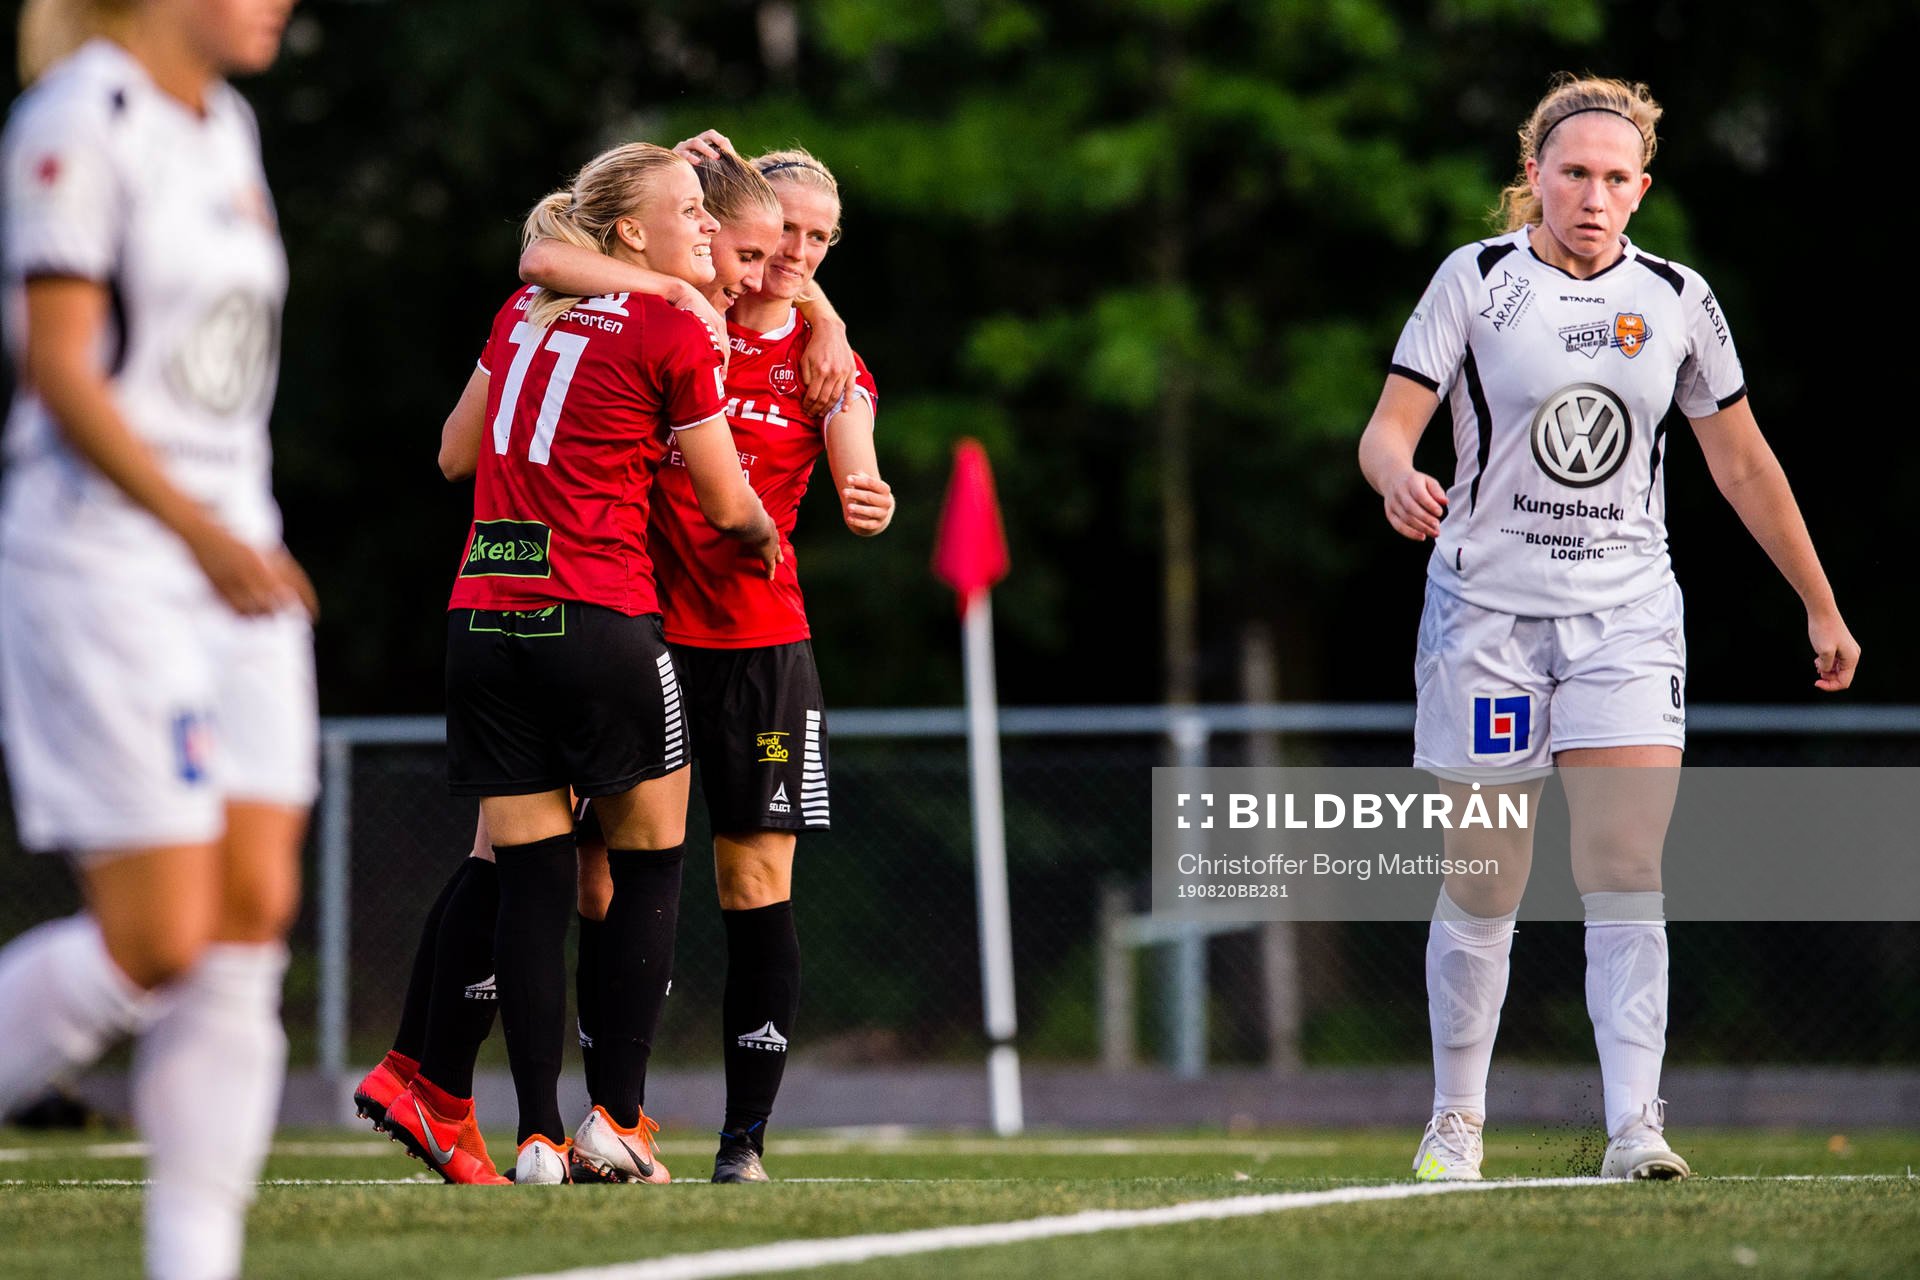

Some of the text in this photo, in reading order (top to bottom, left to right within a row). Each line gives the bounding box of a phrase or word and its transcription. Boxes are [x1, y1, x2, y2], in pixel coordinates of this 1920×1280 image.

[1701, 294, 1728, 347] RASTA
[1568, 328, 1606, 344] HOT
[493, 321, 590, 466] 11
[469, 535, 516, 562] akea
[1525, 532, 1585, 548] BLONDIE
[1670, 674, 1681, 709] 8
[769, 802, 791, 813] SELECT
[737, 1040, 787, 1052] SELECT
